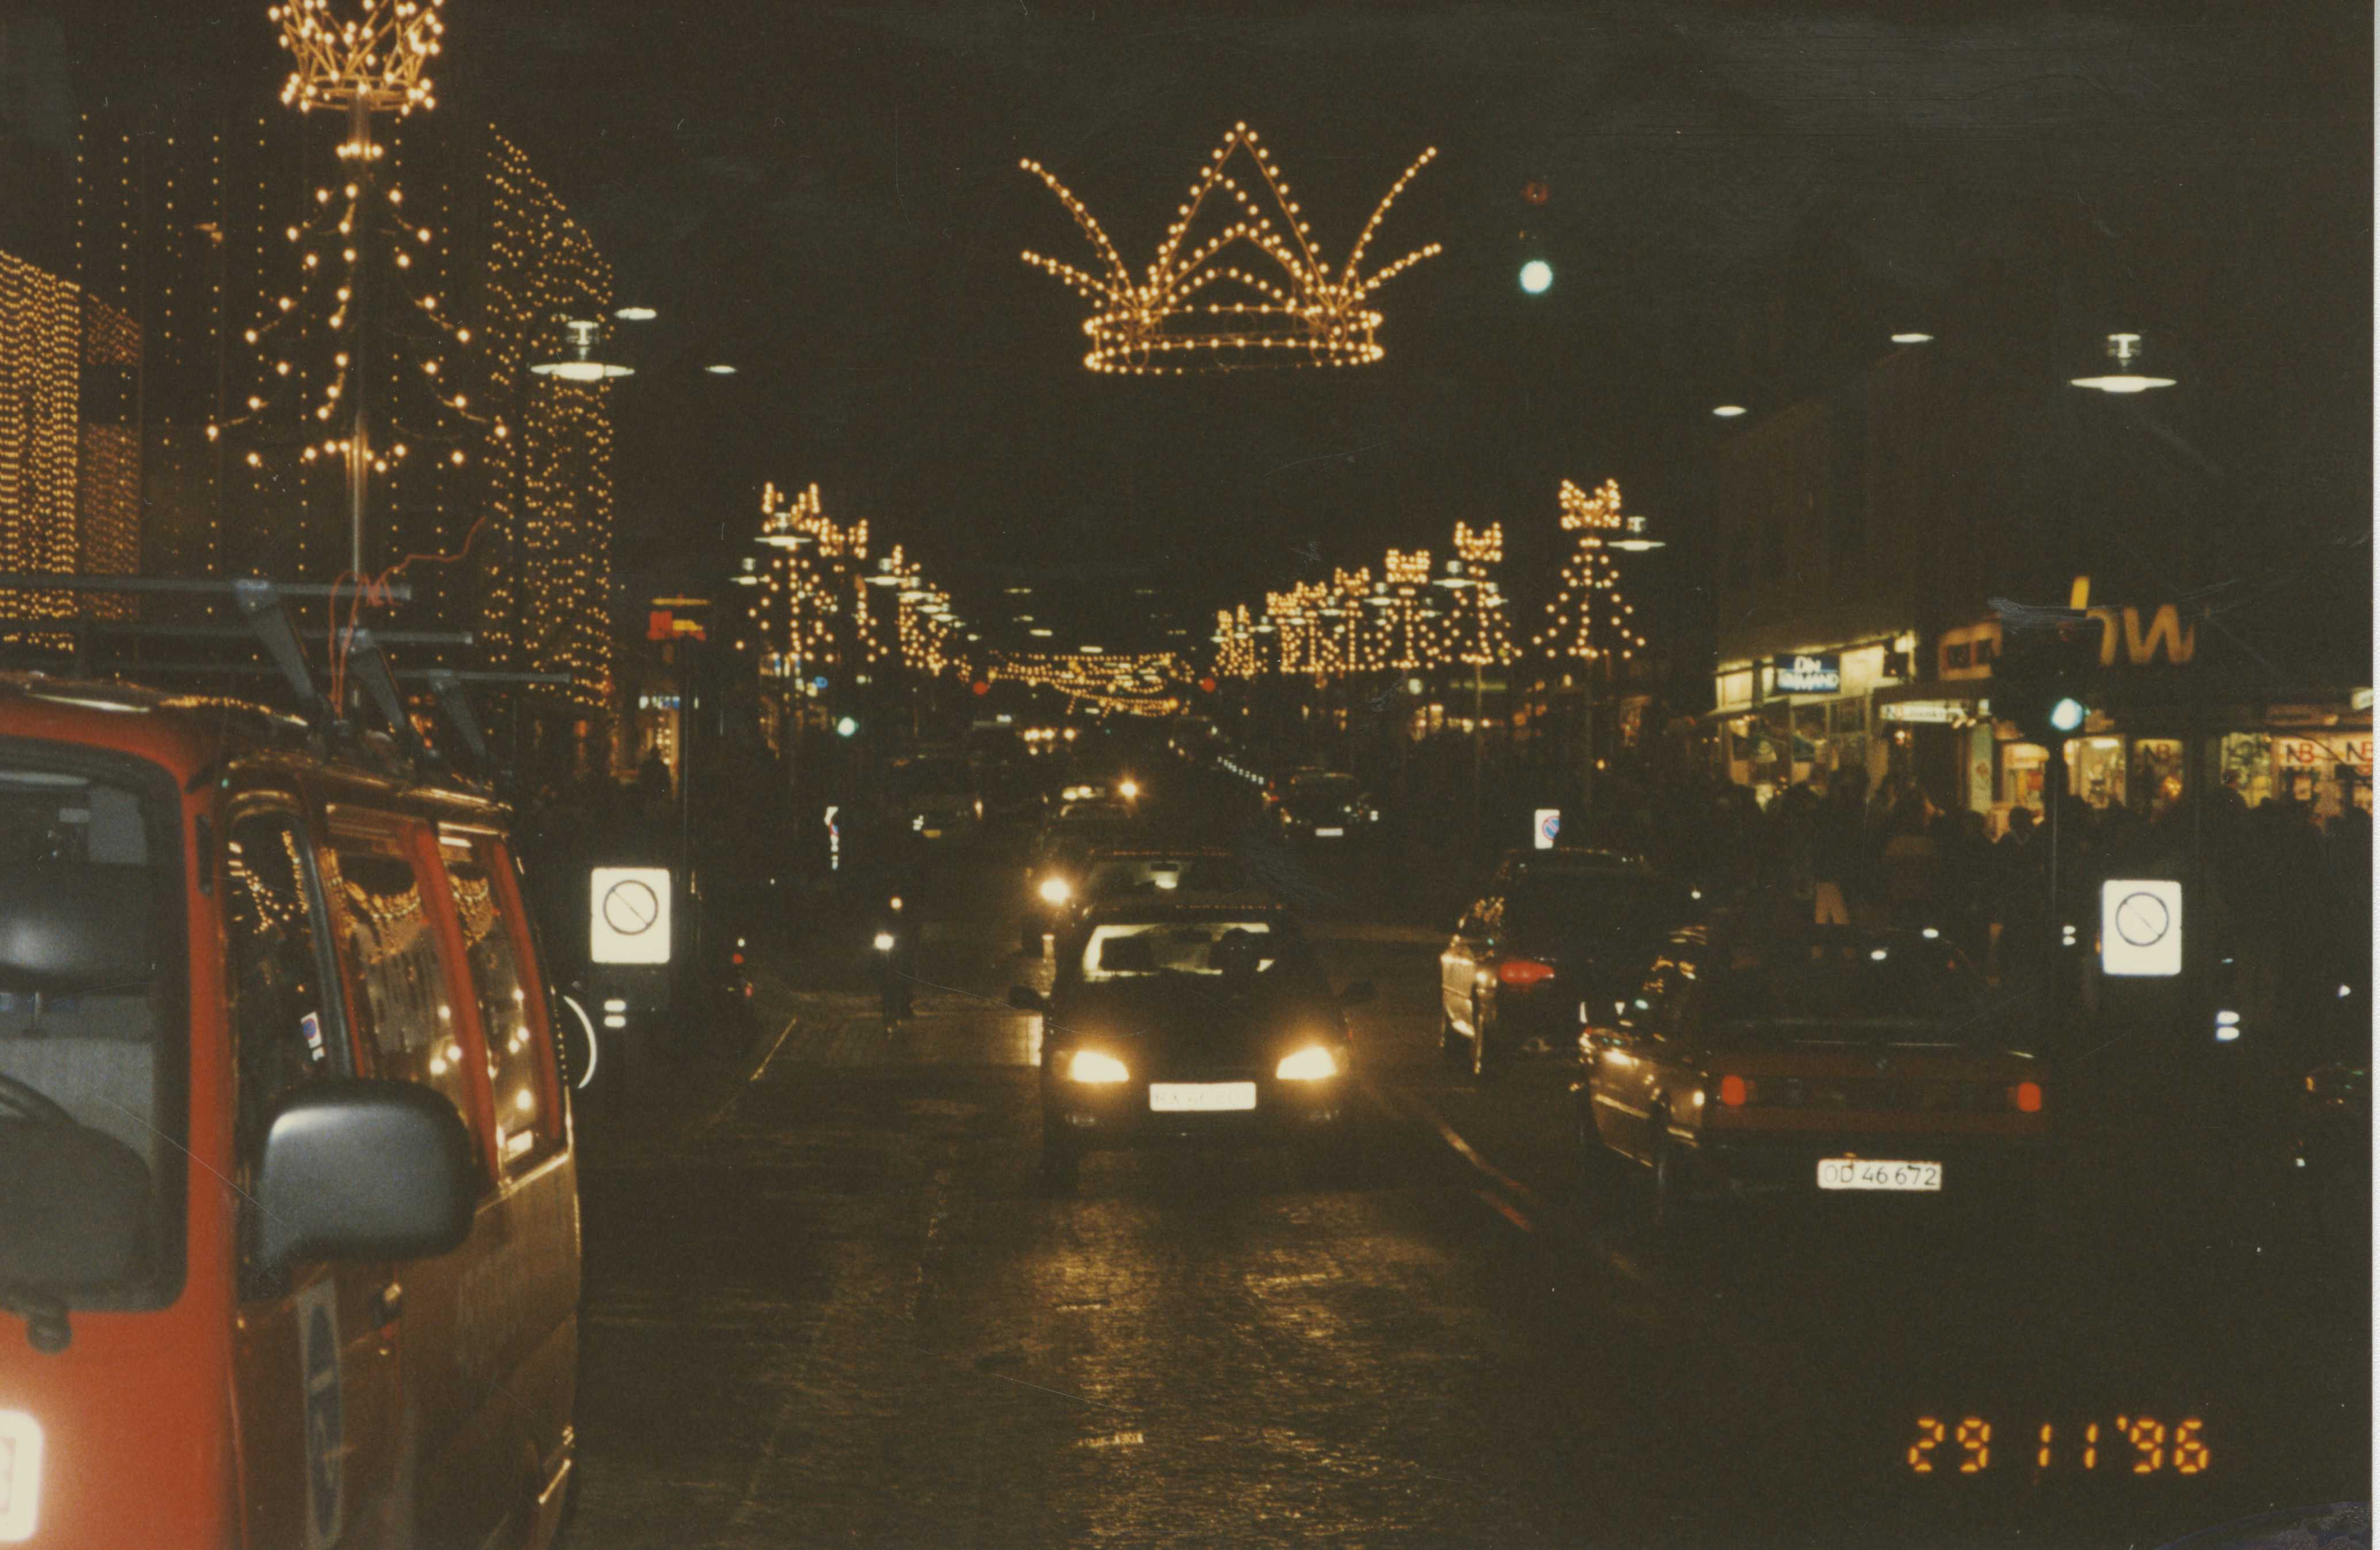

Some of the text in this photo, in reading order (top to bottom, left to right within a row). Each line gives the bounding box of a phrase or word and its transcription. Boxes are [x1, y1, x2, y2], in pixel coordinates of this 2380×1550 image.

[2286, 742, 2315, 764] NB
[1824, 1164, 1937, 1186] OD 46 672
